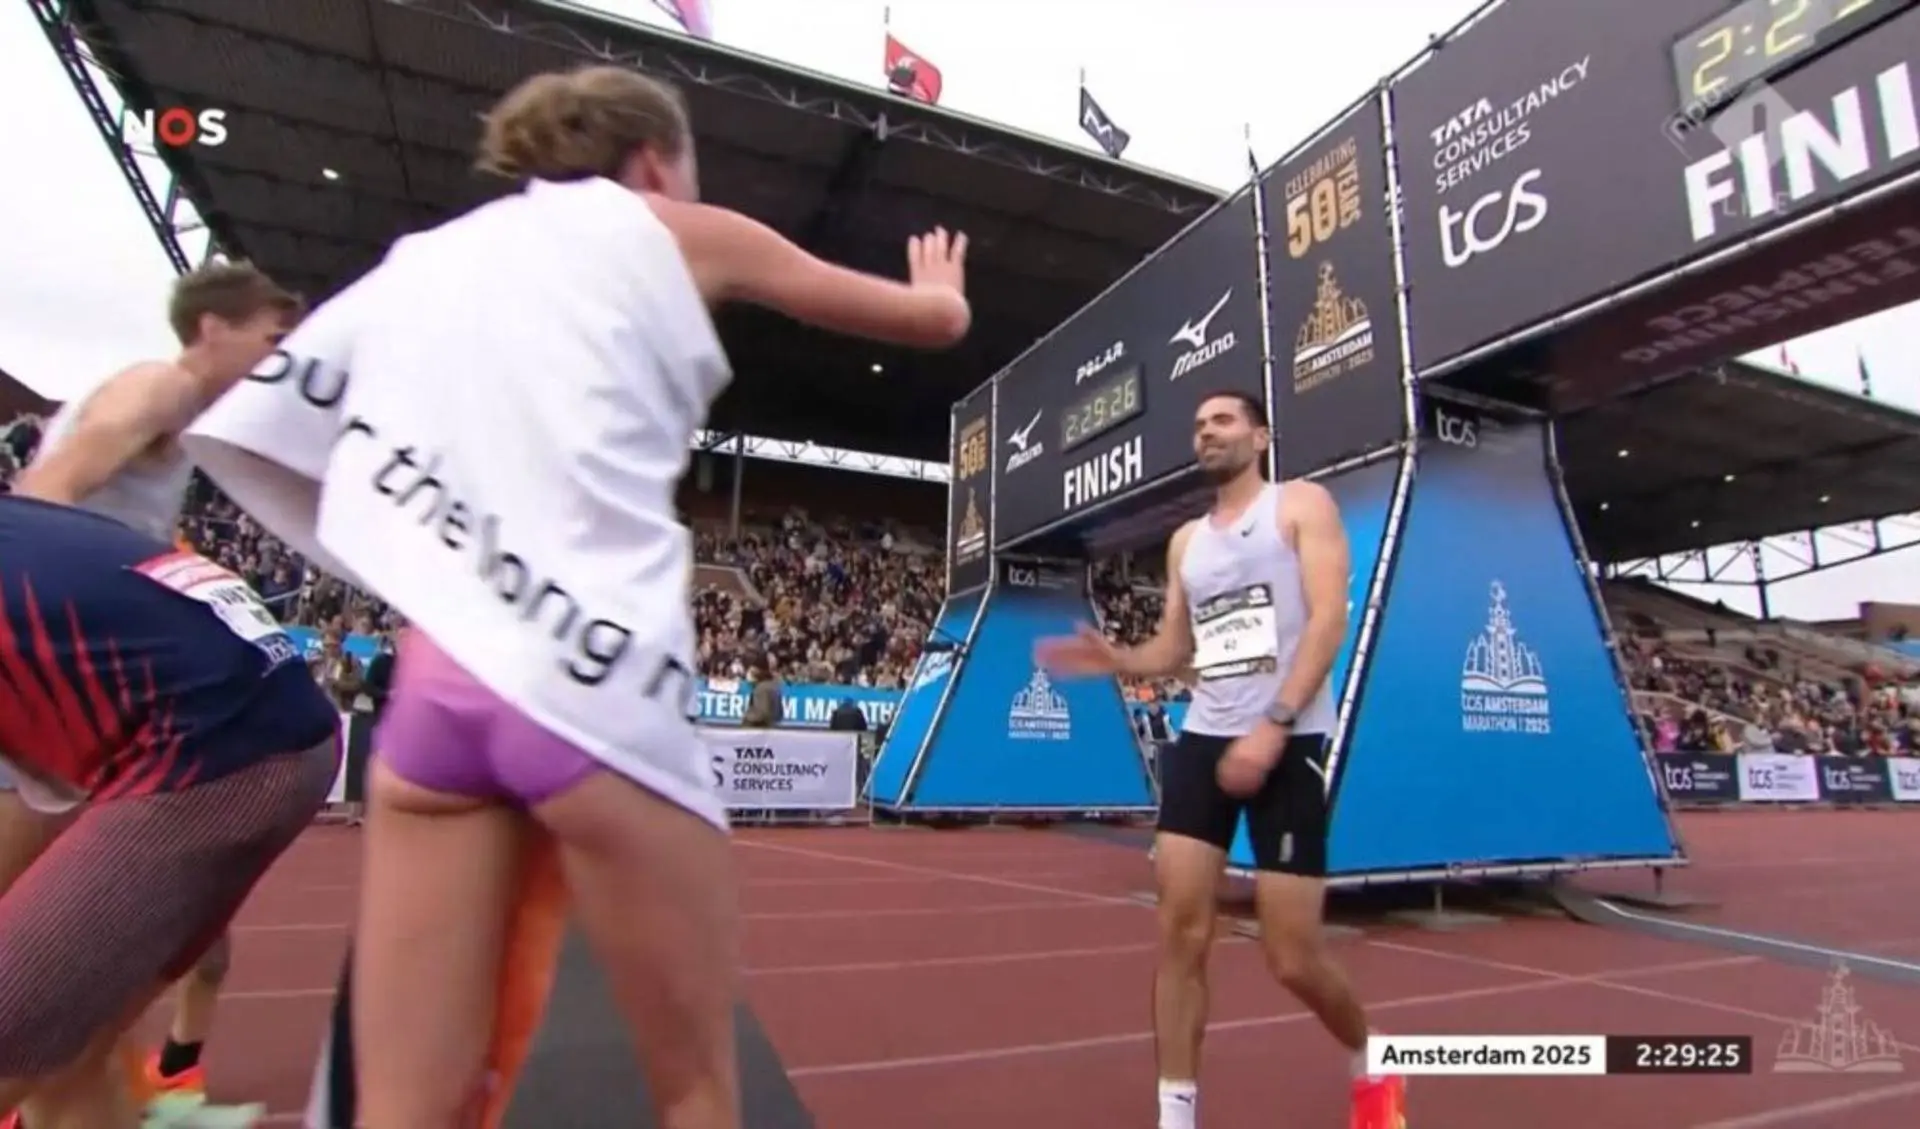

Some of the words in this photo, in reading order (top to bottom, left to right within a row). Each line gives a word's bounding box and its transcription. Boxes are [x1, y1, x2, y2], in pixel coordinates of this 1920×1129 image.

[1693, 0, 1876, 95] 2:2
[1430, 97, 1493, 146] TATA
[1433, 54, 1591, 170] CONSULTANCY
[1436, 121, 1531, 194] SERVICES
[1684, 61, 1920, 242] FINI
[1286, 177, 1338, 260] 50
[1439, 168, 1548, 268] tcs
[1074, 340, 1125, 386] POLAR
[1312, 331, 1373, 371] AMSTERDAM
[1062, 435, 1143, 511] FINISH
[1484, 695, 1549, 714] AMSTERDAM
[733, 747, 775, 760] TATA
[733, 762, 829, 778] CONSULTANCY
[733, 778, 794, 792] SERVICES
